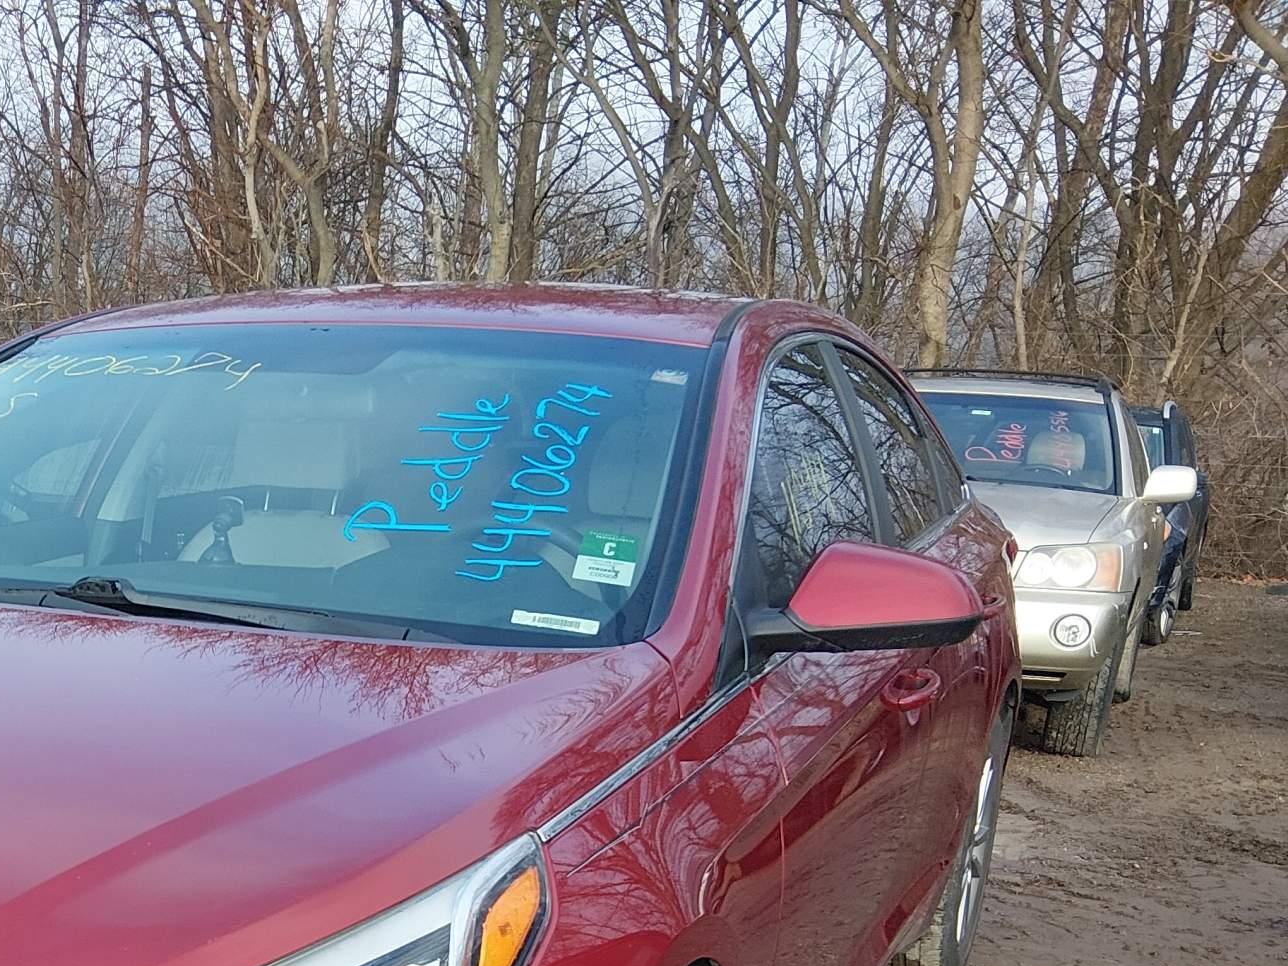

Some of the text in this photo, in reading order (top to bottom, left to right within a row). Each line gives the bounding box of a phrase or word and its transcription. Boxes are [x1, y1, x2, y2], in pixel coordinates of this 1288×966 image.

[343, 393, 511, 542] Peddle
[455, 383, 613, 581] 44406274
[964, 423, 1028, 464] Peddle
